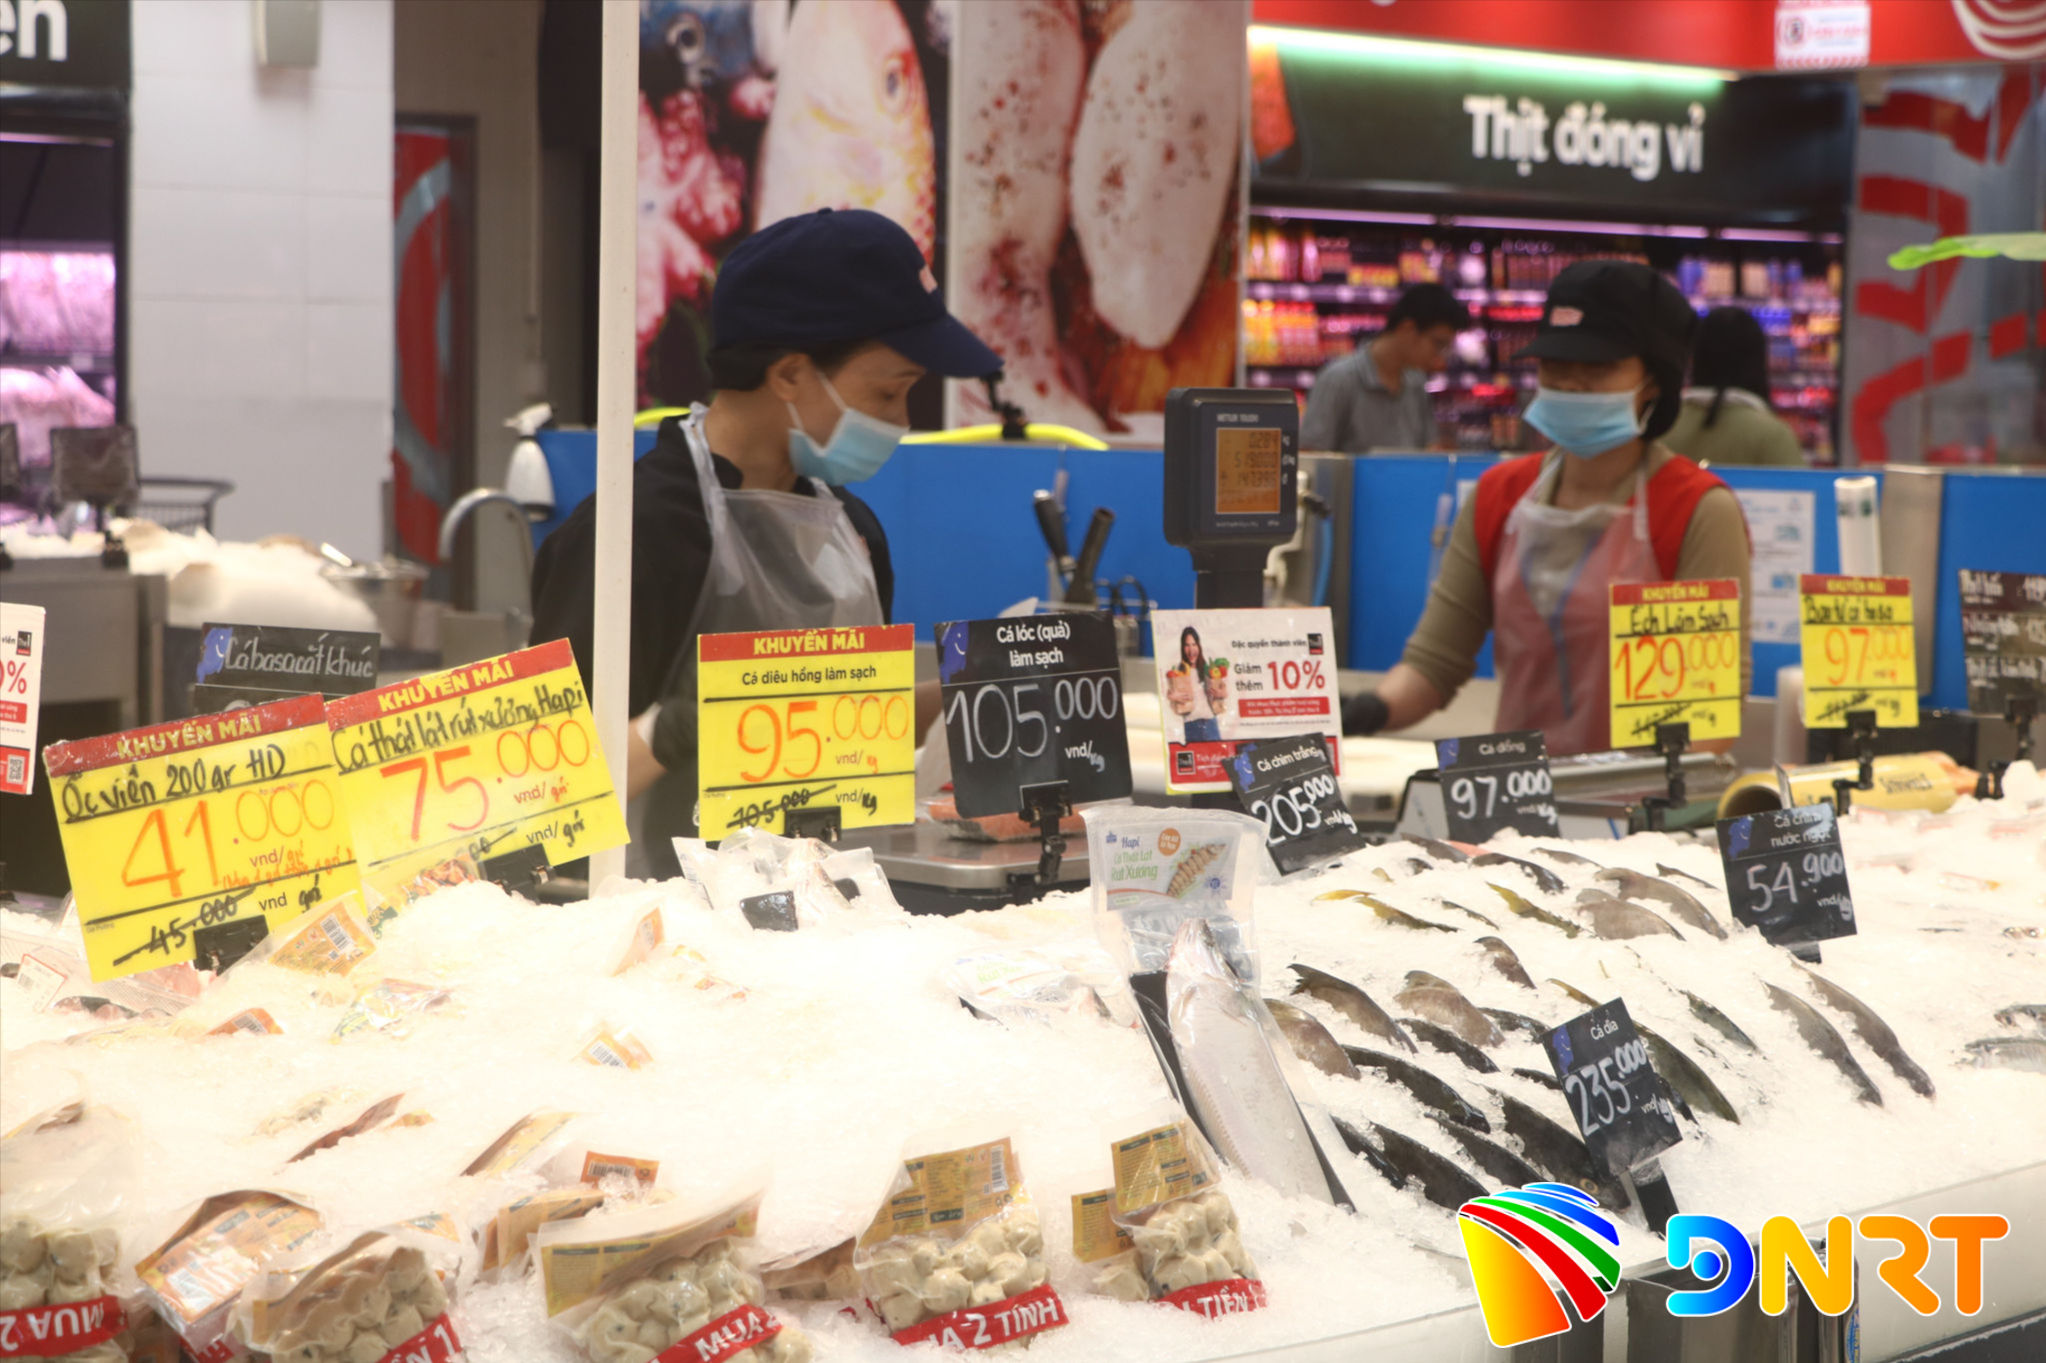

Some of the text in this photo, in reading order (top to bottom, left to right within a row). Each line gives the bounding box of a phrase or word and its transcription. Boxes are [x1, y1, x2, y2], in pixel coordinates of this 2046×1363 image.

[1463, 94, 1549, 177] Thịt
[1554, 100, 1661, 181] đóng
[753, 630, 865, 655] KHUYẾN MÃI
[996, 620, 1071, 643] Cá lóc (quả)
[324, 645, 374, 678] khúc
[1009, 647, 1064, 669] làm sạch
[1233, 662, 1262, 675] Giảm
[742, 666, 877, 686] Cá diêu hồng làm sạch
[1235, 680, 1264, 692] thêm
[1267, 660, 1326, 691] 10%
[534, 681, 583, 717] Hapi
[116, 712, 263, 759] KHUYẾN MÃI
[946, 676, 1119, 764] 105.000
[737, 695, 910, 782] 95.000
[1478, 739, 1526, 755] Cá đồng
[1256, 744, 1318, 773] Cá chim trắng
[379, 719, 590, 842] 75.000
[1450, 768, 1553, 820] 97.000
[1774, 815, 1790, 828] Cá
[121, 779, 335, 898] 41.000
[1121, 836, 1140, 849] Hapi
[1770, 833, 1801, 848] nước
[1746, 851, 1844, 913] 54.900
[258, 892, 288, 912] vnd
[1590, 1024, 1604, 1040] Cá
[1565, 1039, 1648, 1137] 235.000
[27, 1302, 104, 1340] MUA
[994, 1297, 1060, 1337] TÍNH
[694, 1311, 764, 1363] MUA
